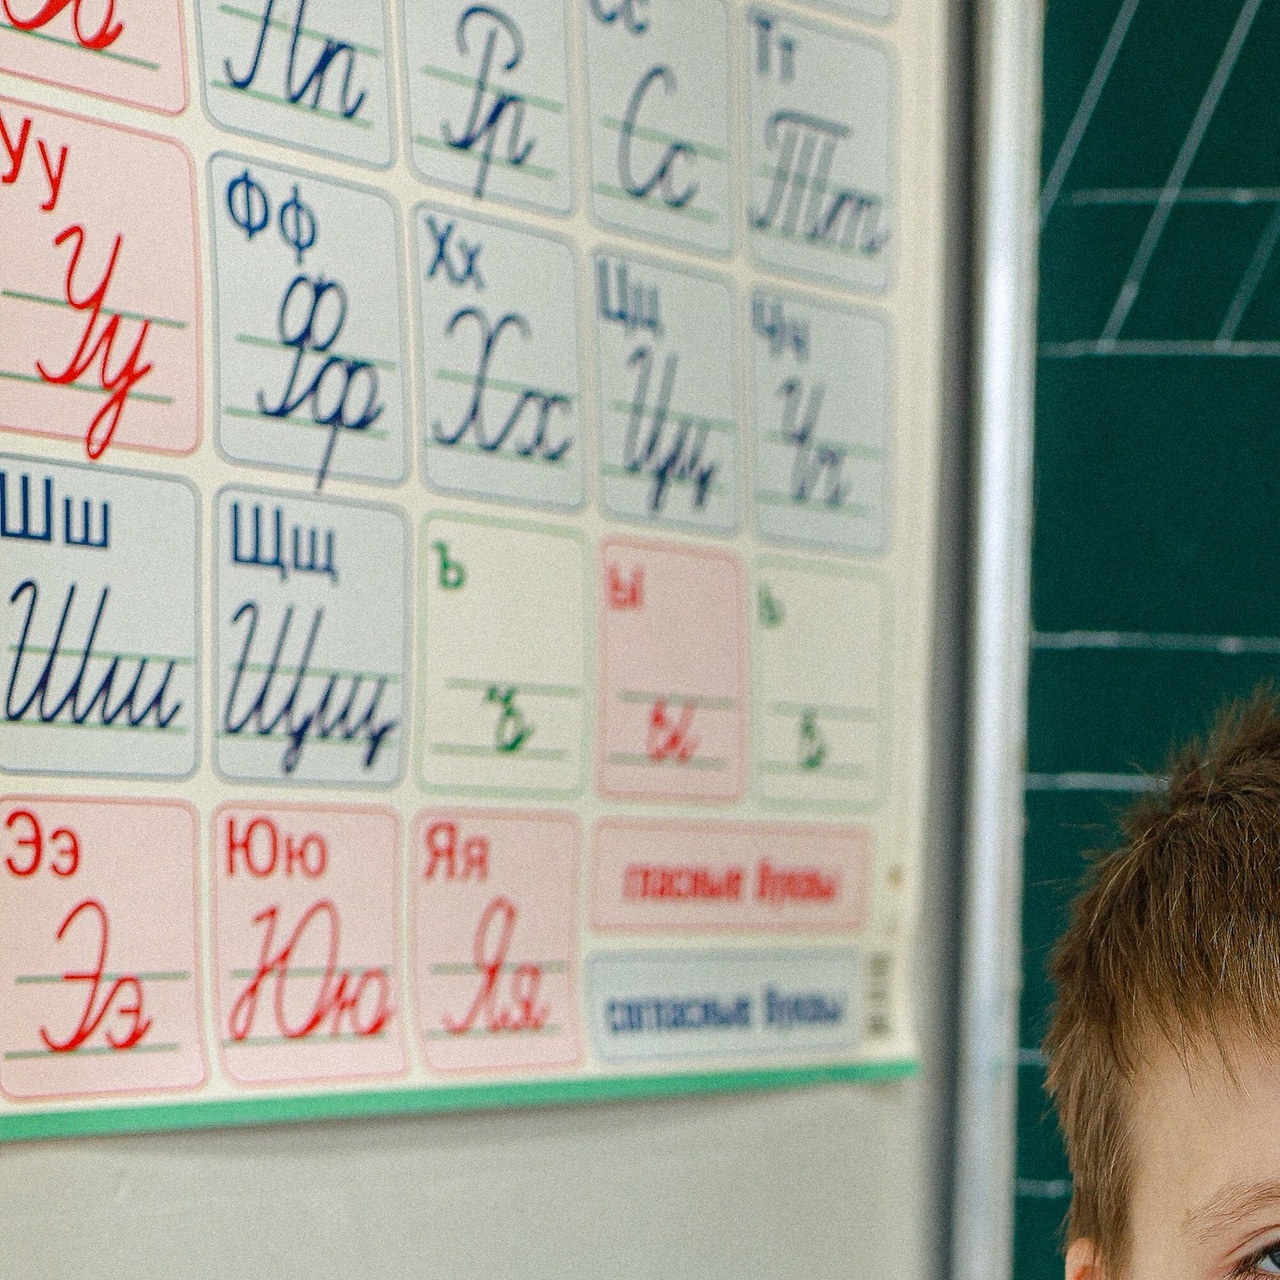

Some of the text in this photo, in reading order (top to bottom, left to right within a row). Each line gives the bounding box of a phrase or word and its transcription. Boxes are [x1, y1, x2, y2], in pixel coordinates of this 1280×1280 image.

[0, 117, 69, 211] Уу
[441, 4, 537, 199] Рр
[617, 63, 699, 210] Сс
[226, 169, 318, 266] Фф
[425, 215, 485, 291] Хх
[36, 225, 155, 461] Уу
[597, 256, 663, 338] Цц
[257, 274, 385, 493] Фф
[431, 306, 574, 463] Хх
[622, 345, 724, 514] Цц
[0, 471, 109, 549] Шш
[232, 502, 338, 582] Щщ
[3, 578, 181, 728] Шш
[223, 599, 397, 774] Щщ
[4, 808, 82, 877] Ээ
[224, 816, 330, 880] Юю
[424, 819, 491, 882] Яя
[38, 897, 153, 1052] Ээ
[228, 897, 394, 1043] Юю
[440, 893, 552, 1037] Яя
